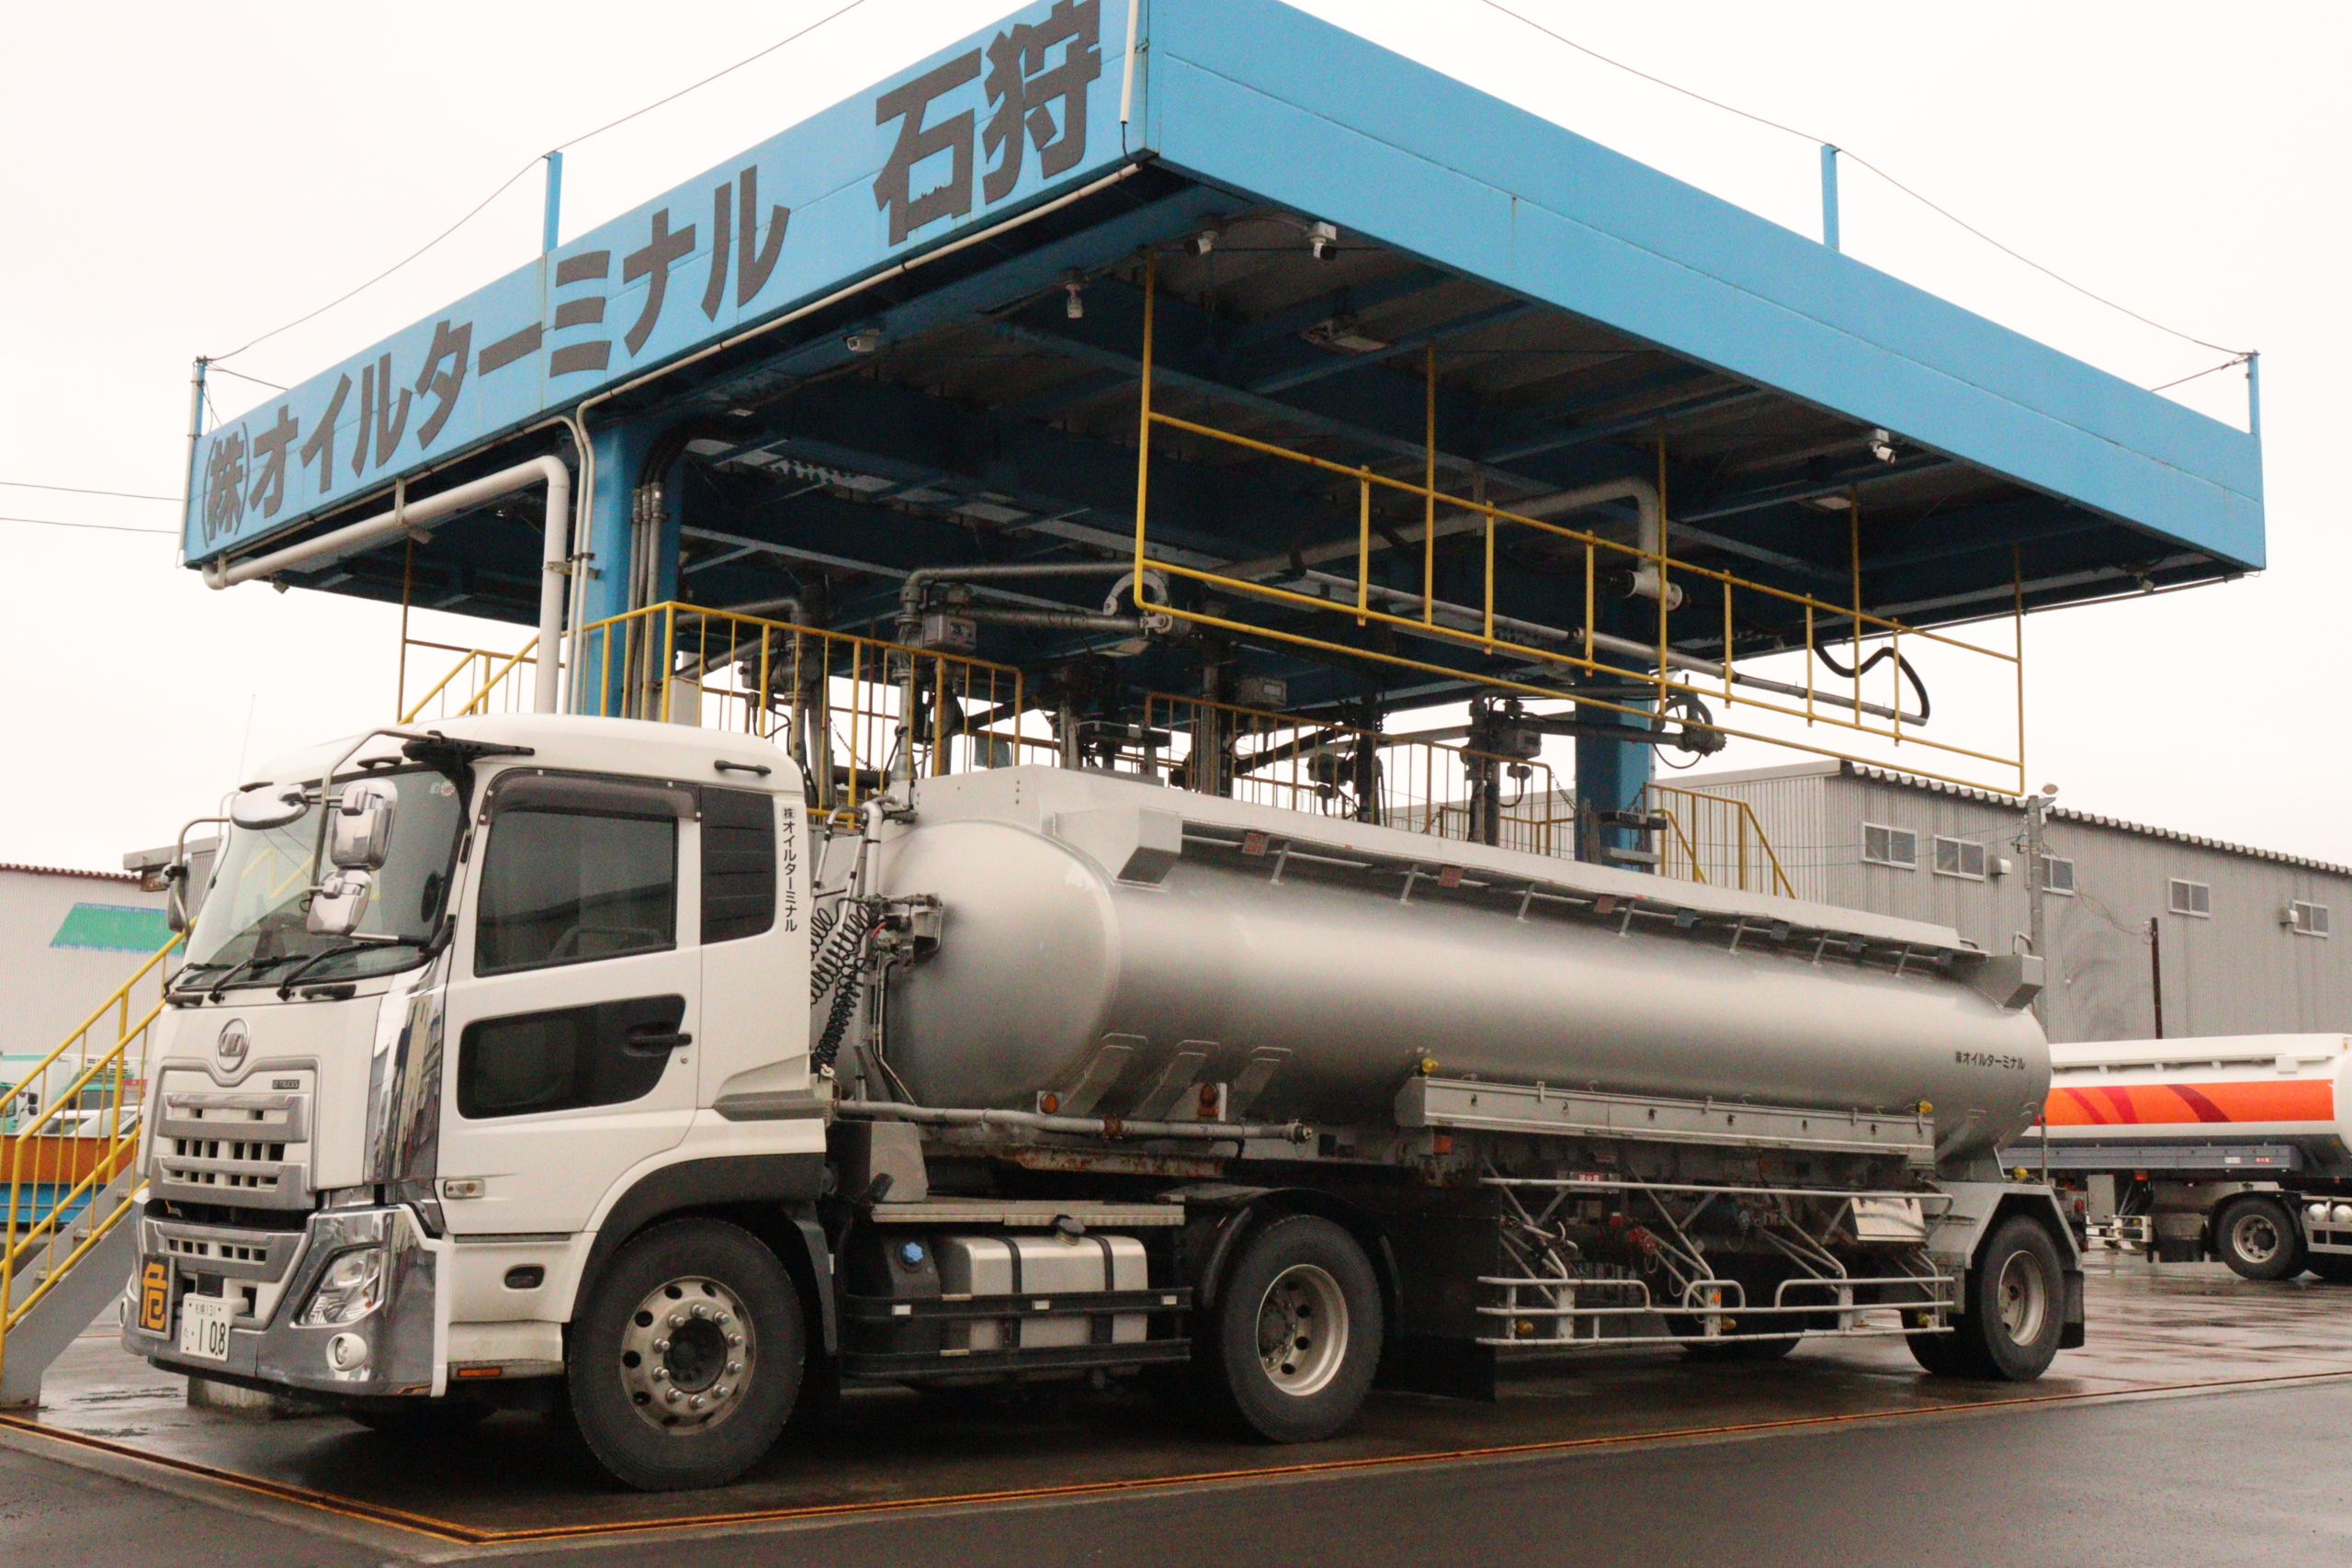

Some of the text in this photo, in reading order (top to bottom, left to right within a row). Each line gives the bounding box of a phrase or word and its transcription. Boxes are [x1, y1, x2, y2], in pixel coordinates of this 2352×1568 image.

[201, 0, 1102, 548] (株)オイルターミナル 石狩
[141, 1261, 168, 1330] 危
